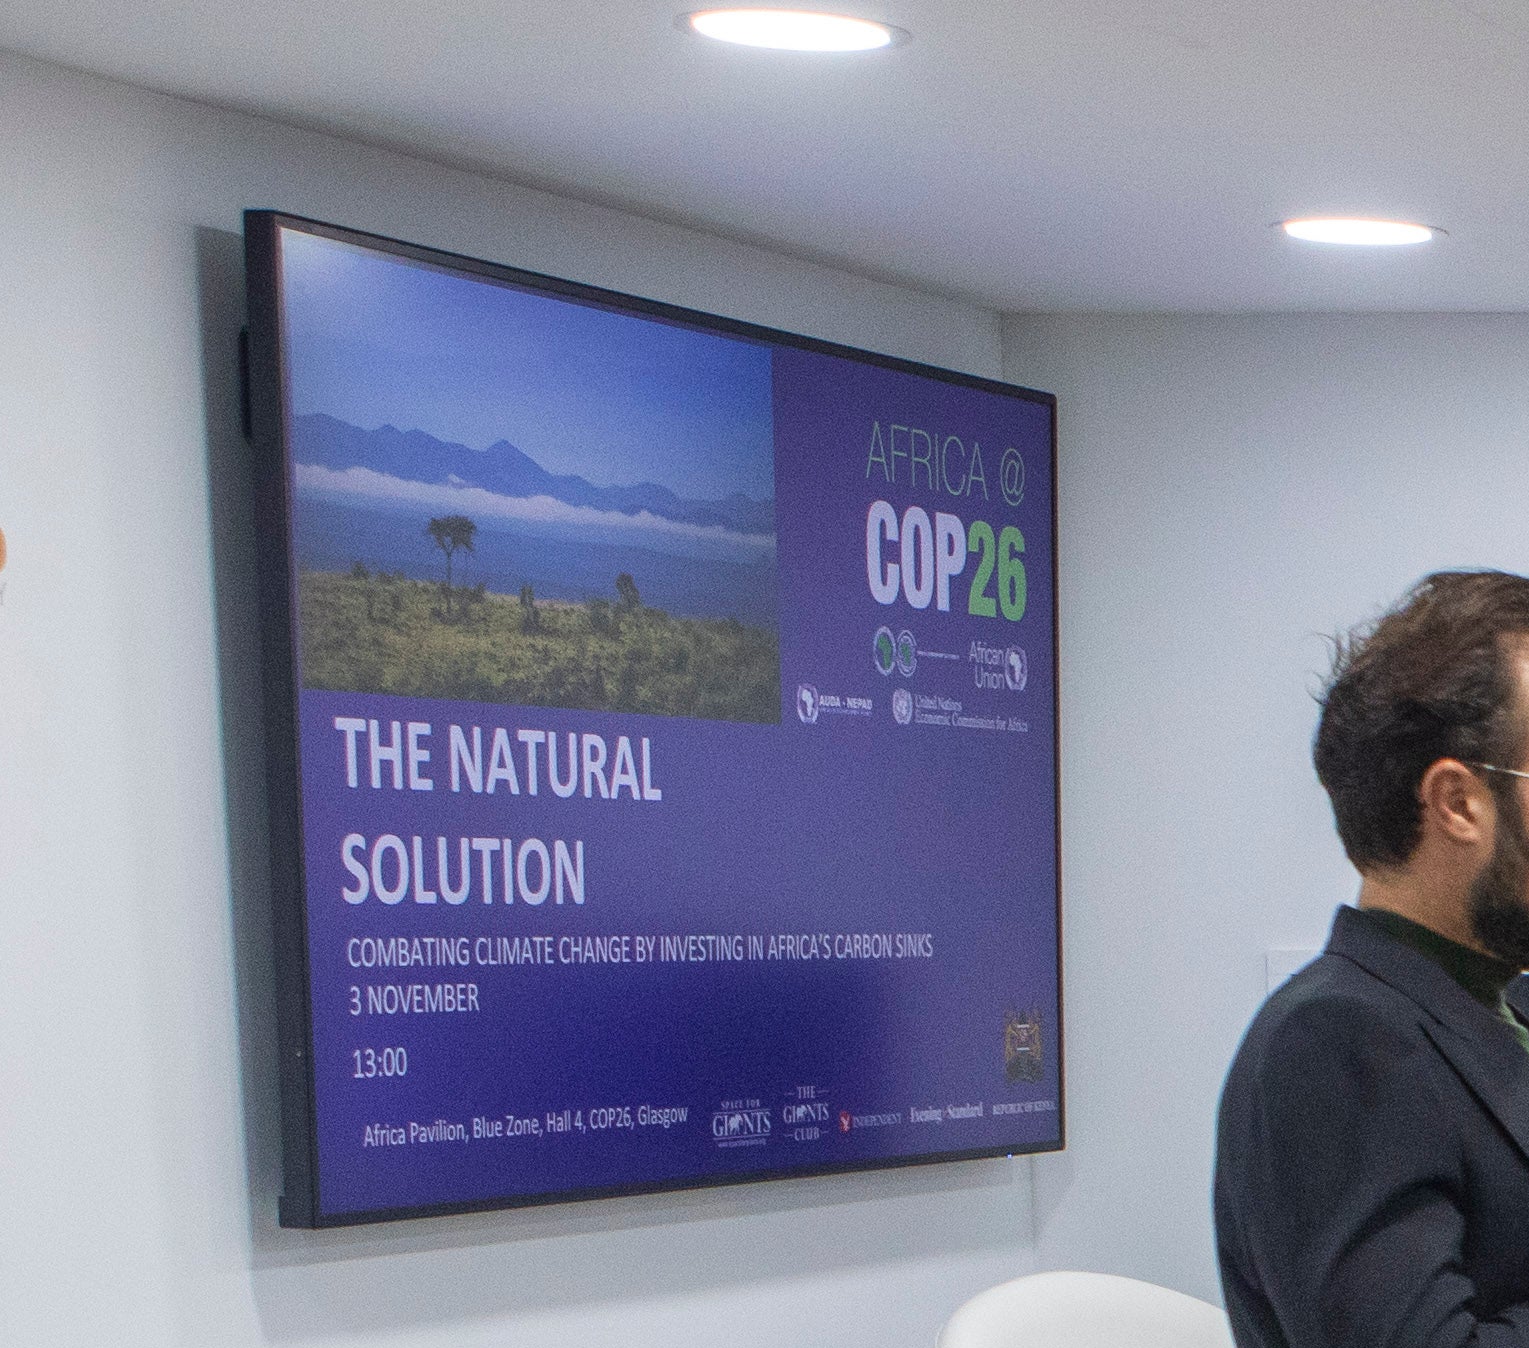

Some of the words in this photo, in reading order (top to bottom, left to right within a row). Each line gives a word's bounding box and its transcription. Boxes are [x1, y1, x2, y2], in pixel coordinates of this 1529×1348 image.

[866, 420, 989, 501] AFRICA
[1000, 447, 1025, 507] @
[866, 499, 1028, 622] COP26
[969, 641, 1006, 666] African
[974, 667, 1006, 690] Union
[334, 716, 434, 792] THE
[449, 724, 663, 802] NATURAL
[341, 832, 585, 906] SOLUTION
[348, 937, 471, 968] COMBATING
[475, 936, 555, 967] CLIMATE
[558, 935, 631, 964] CHANGE
[636, 935, 656, 963] BY
[660, 935, 744, 962] INVESTING
[748, 935, 764, 961] IN
[767, 933, 832, 960] AFRICA'S
[834, 933, 892, 959] CARBON
[896, 933, 934, 959] SINKS
[350, 985, 362, 1016] 3
[367, 983, 481, 1016] NOVEMBER
[352, 1046, 408, 1080] 13:00
[796, 1085, 816, 1100] THE
[362, 1124, 406, 1148] Africa
[410, 1118, 470, 1144] Pavilion,
[472, 1116, 503, 1140] Blue
[506, 1115, 543, 1138] Zone,
[546, 1110, 572, 1133] Hall
[574, 1110, 587, 1134] 4,
[589, 1107, 635, 1130] COP26,
[637, 1105, 689, 1129] Glasgow
[793, 1126, 820, 1142] CLUB
